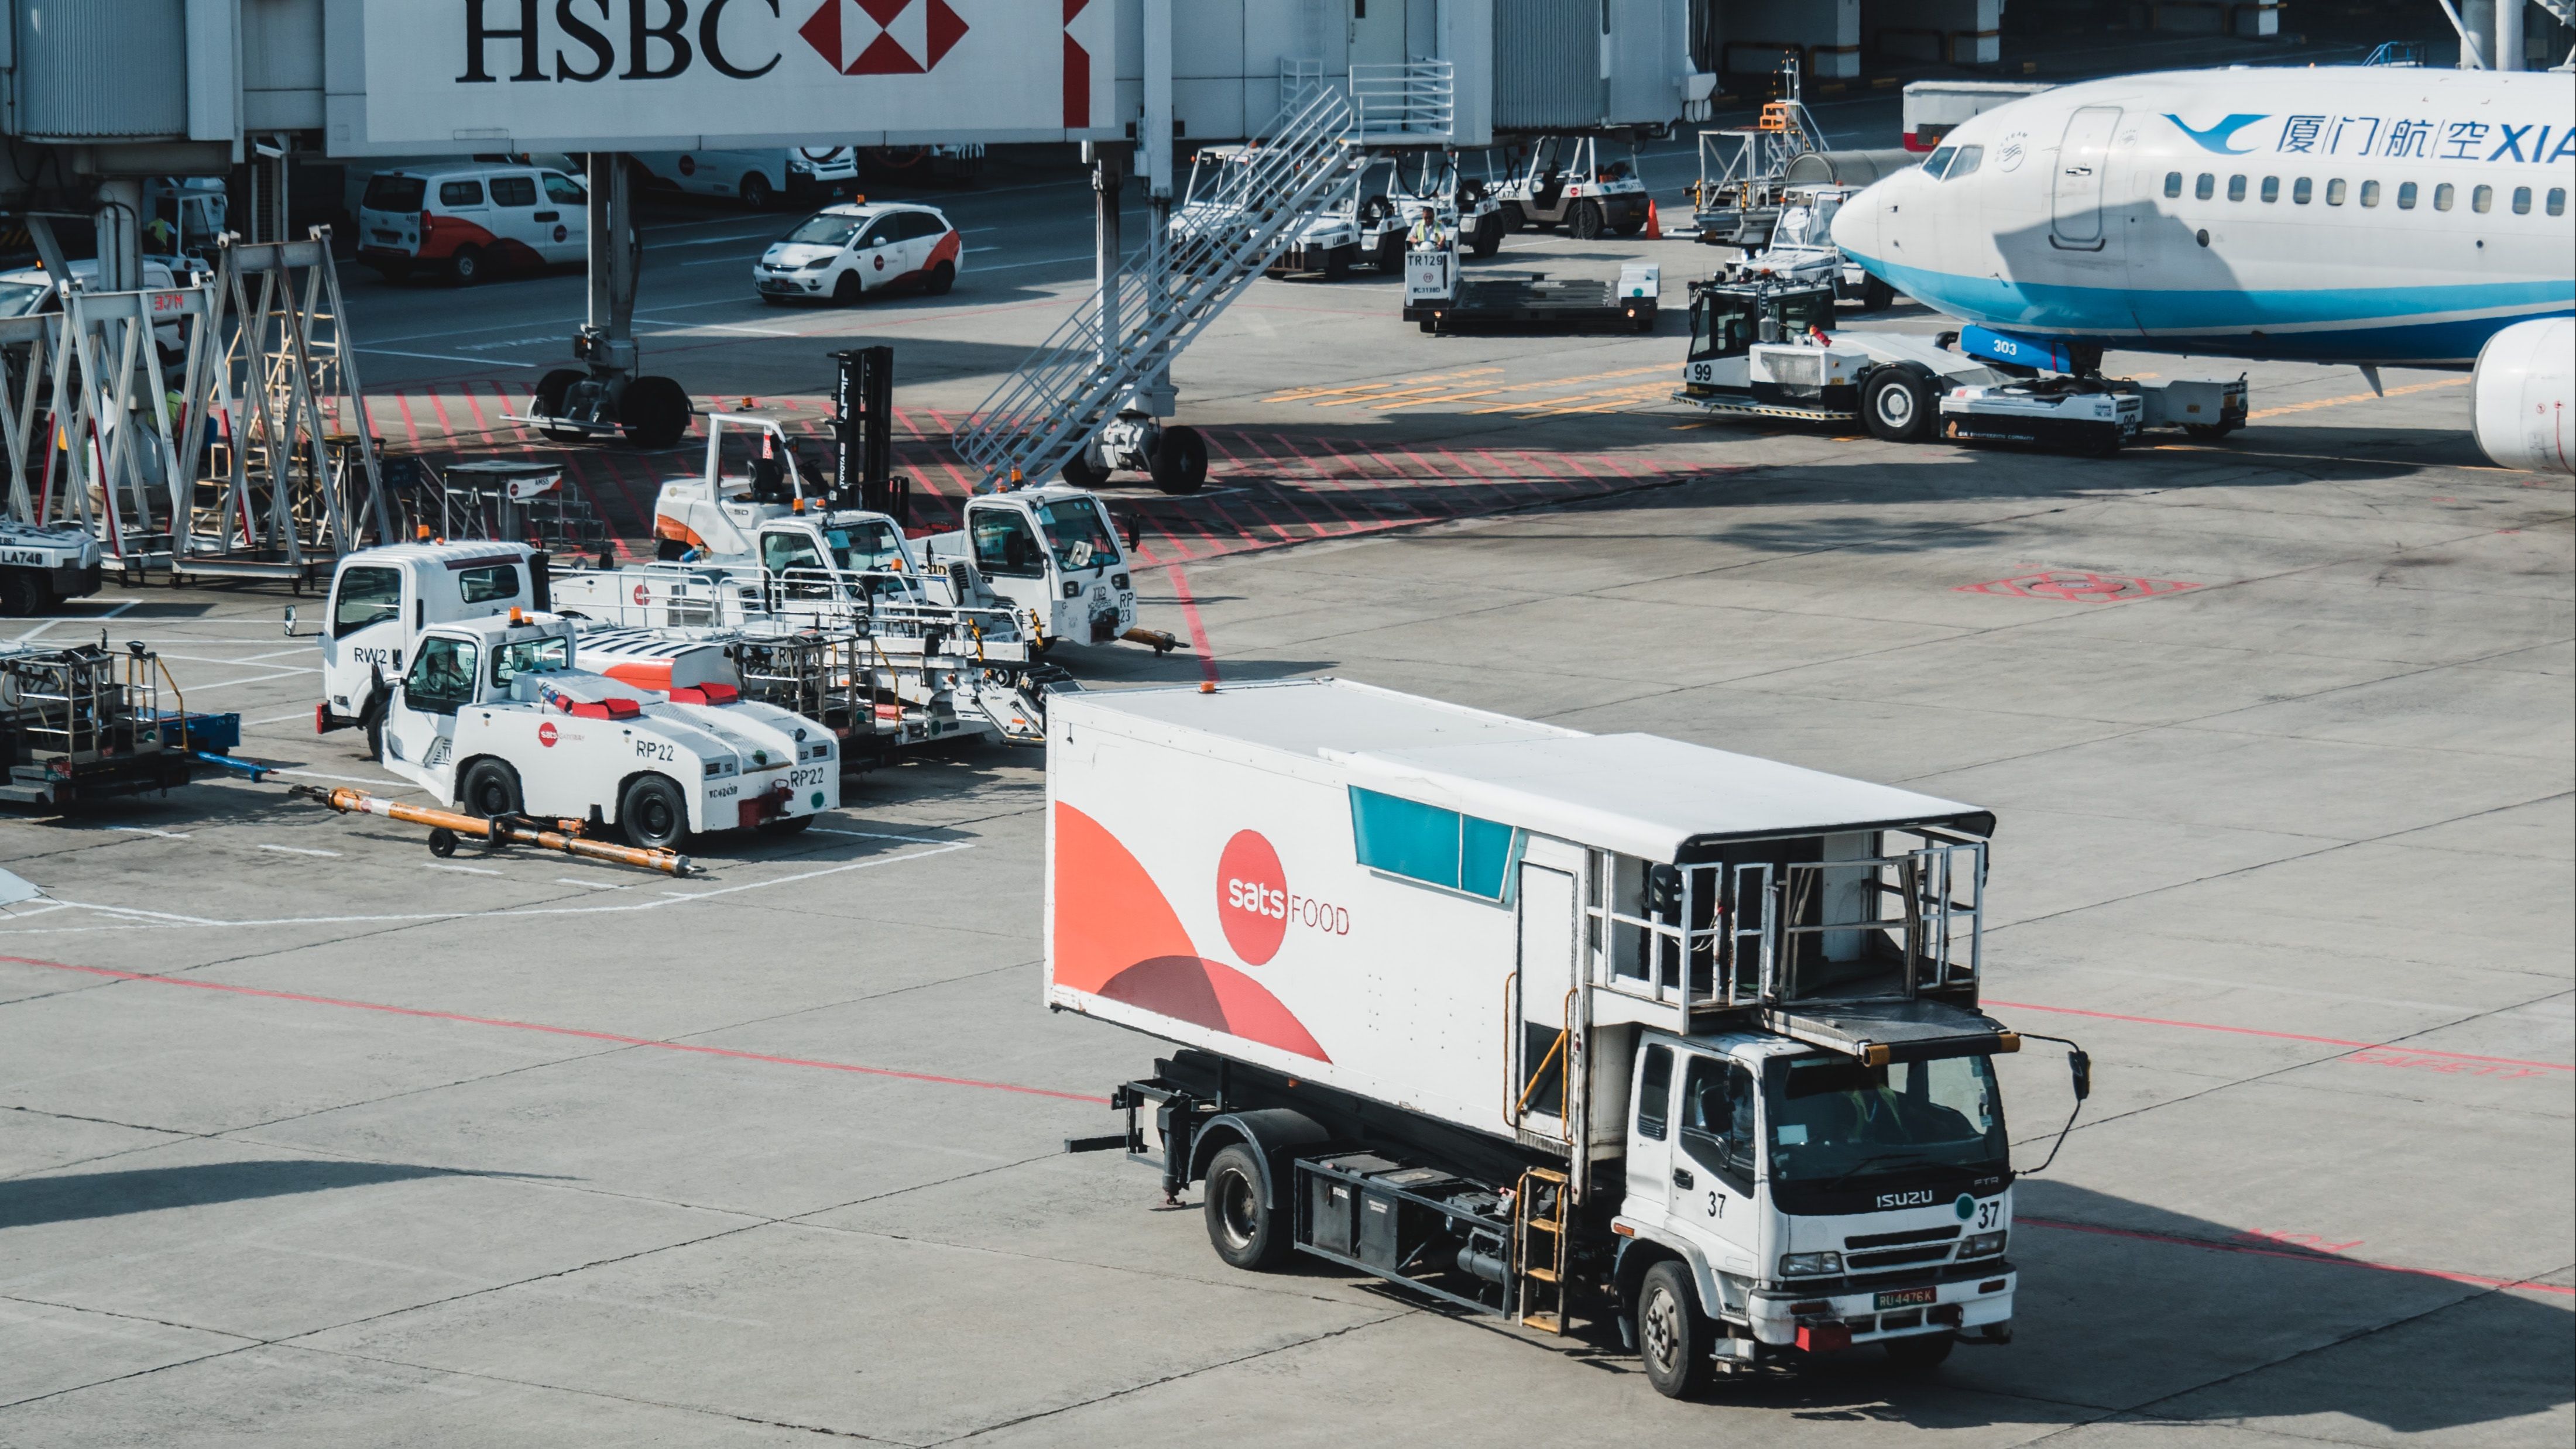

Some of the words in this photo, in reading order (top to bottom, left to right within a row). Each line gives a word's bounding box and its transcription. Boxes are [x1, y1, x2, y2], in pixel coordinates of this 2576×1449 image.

[455, 0, 783, 83] HSBC
[2276, 115, 2489, 160] 厦门航空
[1408, 255, 1443, 266] TR129
[1993, 339, 2018, 356] 303
[1694, 363, 1711, 381] 99
[1120, 592, 1134, 608] RP
[1120, 609, 1131, 624] 23
[355, 647, 387, 664] RW2
[540, 730, 558, 739] sats
[636, 740, 674, 762] RP22
[791, 767, 824, 788] RP22
[1229, 878, 1285, 920] sats
[1291, 894, 1350, 936] FOOD
[2337, 1052, 2548, 1080] SAFETY
[1974, 1176, 1999, 1186] FTR
[1707, 1190, 1727, 1220] 37
[1877, 1190, 1933, 1208] ISUZU
[1978, 1200, 2000, 1229] 37
